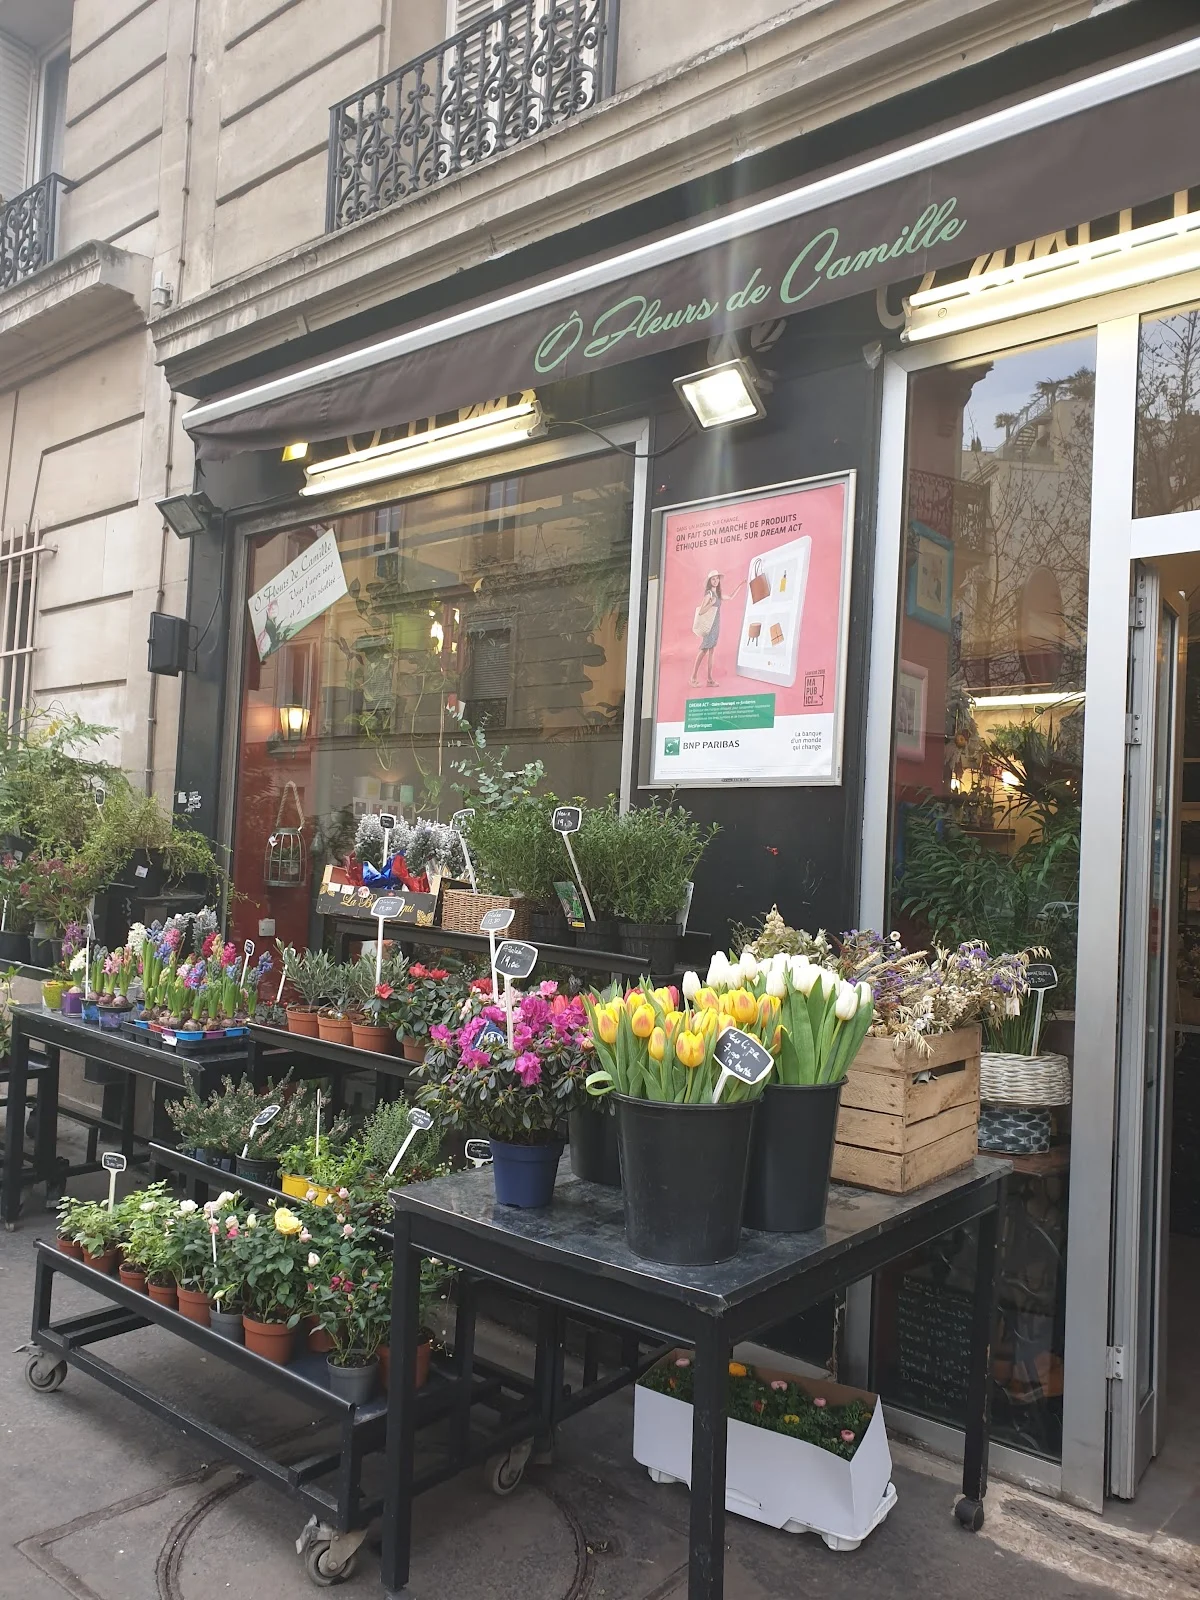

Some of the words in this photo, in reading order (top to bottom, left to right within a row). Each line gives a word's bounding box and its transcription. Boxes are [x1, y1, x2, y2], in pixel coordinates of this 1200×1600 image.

[584, 295, 719, 358] Fleurs
[726, 268, 771, 312] de
[779, 196, 967, 304] Camille
[676, 534, 686, 542] ON
[687, 531, 701, 540] FAIT
[702, 529, 717, 538] SON
[718, 522, 748, 534] MARCHÉ
[749, 520, 759, 529] DE
[760, 513, 797, 526] PRODUITS
[675, 541, 708, 552] ÉTHIQUES
[709, 538, 719, 546] EN
[720, 534, 742, 544] LIGNE,
[744, 530, 758, 539] SUR
[760, 526, 787, 538] DREAM
[787, 523, 803, 533] ACT
[264, 578, 290, 603] Fleurs
[291, 570, 299, 582] de
[301, 541, 332, 572] Camille
[806, 678, 816, 687] MA
[806, 687, 818, 695] PUB
[683, 742, 700, 750] BNP
[702, 740, 740, 749] PARIBAS
[802, 744, 822, 752] change
